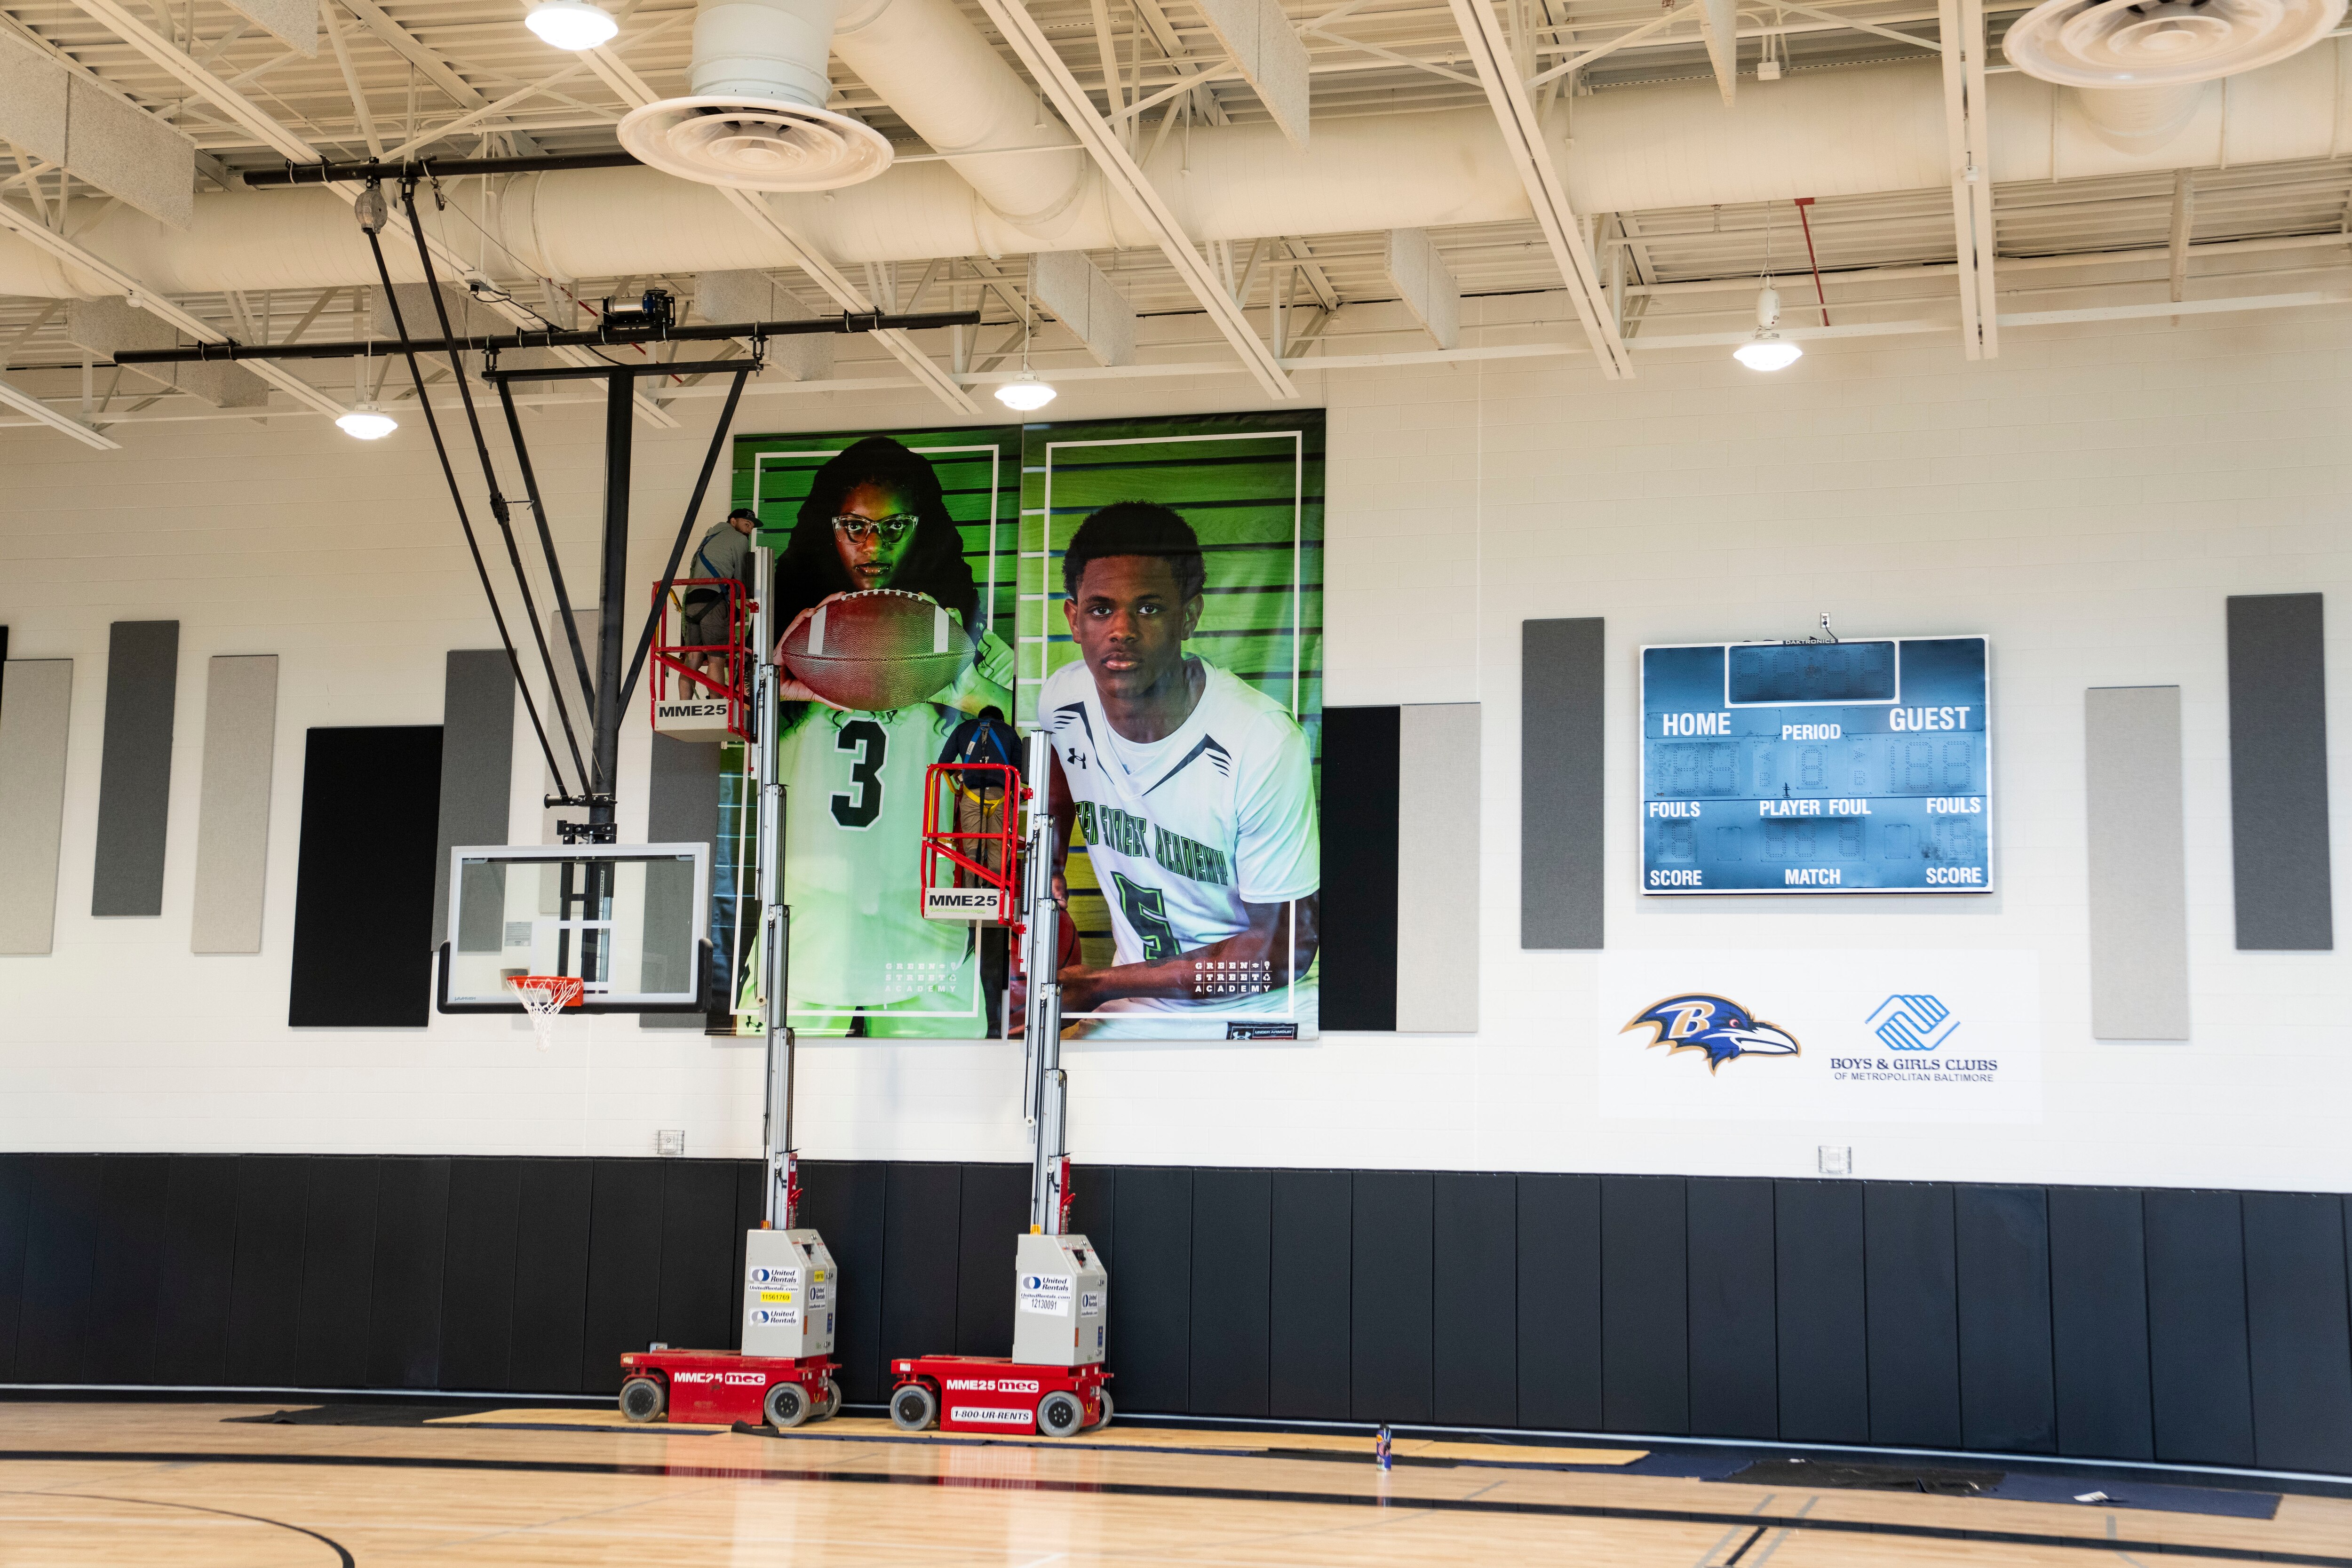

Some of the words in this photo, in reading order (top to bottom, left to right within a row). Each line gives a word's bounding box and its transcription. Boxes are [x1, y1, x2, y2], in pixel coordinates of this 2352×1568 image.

[659, 704, 727, 717] MME25
[1663, 712, 1731, 736] HOME
[1889, 707, 1971, 731] GUEST
[1782, 724, 1841, 740] PERIOD
[828, 716, 890, 832] 3
[1649, 801, 1700, 818] FOULS
[1760, 800, 1820, 816] PLAYER
[1829, 799, 1872, 815] FOUL
[1927, 797, 1981, 814] FOULS
[1099, 804, 1150, 858] STREET
[1154, 823, 1228, 886] ACADEMY
[1650, 870, 1702, 886] SCORE
[1785, 869, 1841, 884] MATCH
[1926, 867, 1982, 884] SCORE
[929, 895, 997, 907] MME25
[1110, 871, 1183, 960] 5
[1655, 1001, 1716, 1039] B
[1830, 1058, 1872, 1069] BOYS
[1876, 1059, 1889, 1069] &
[1893, 1059, 1940, 1070] GIRLS
[1945, 1059, 1998, 1071] CLUBS
[1851, 1073, 1930, 1081] METROPOLITAN
[1032, 1298, 1057, 1310] 12130091
[946, 1379, 996, 1391] MME25
[998, 1382, 1038, 1391] mec
[954, 1410, 1029, 1421] 1-800-UR-RENTS
